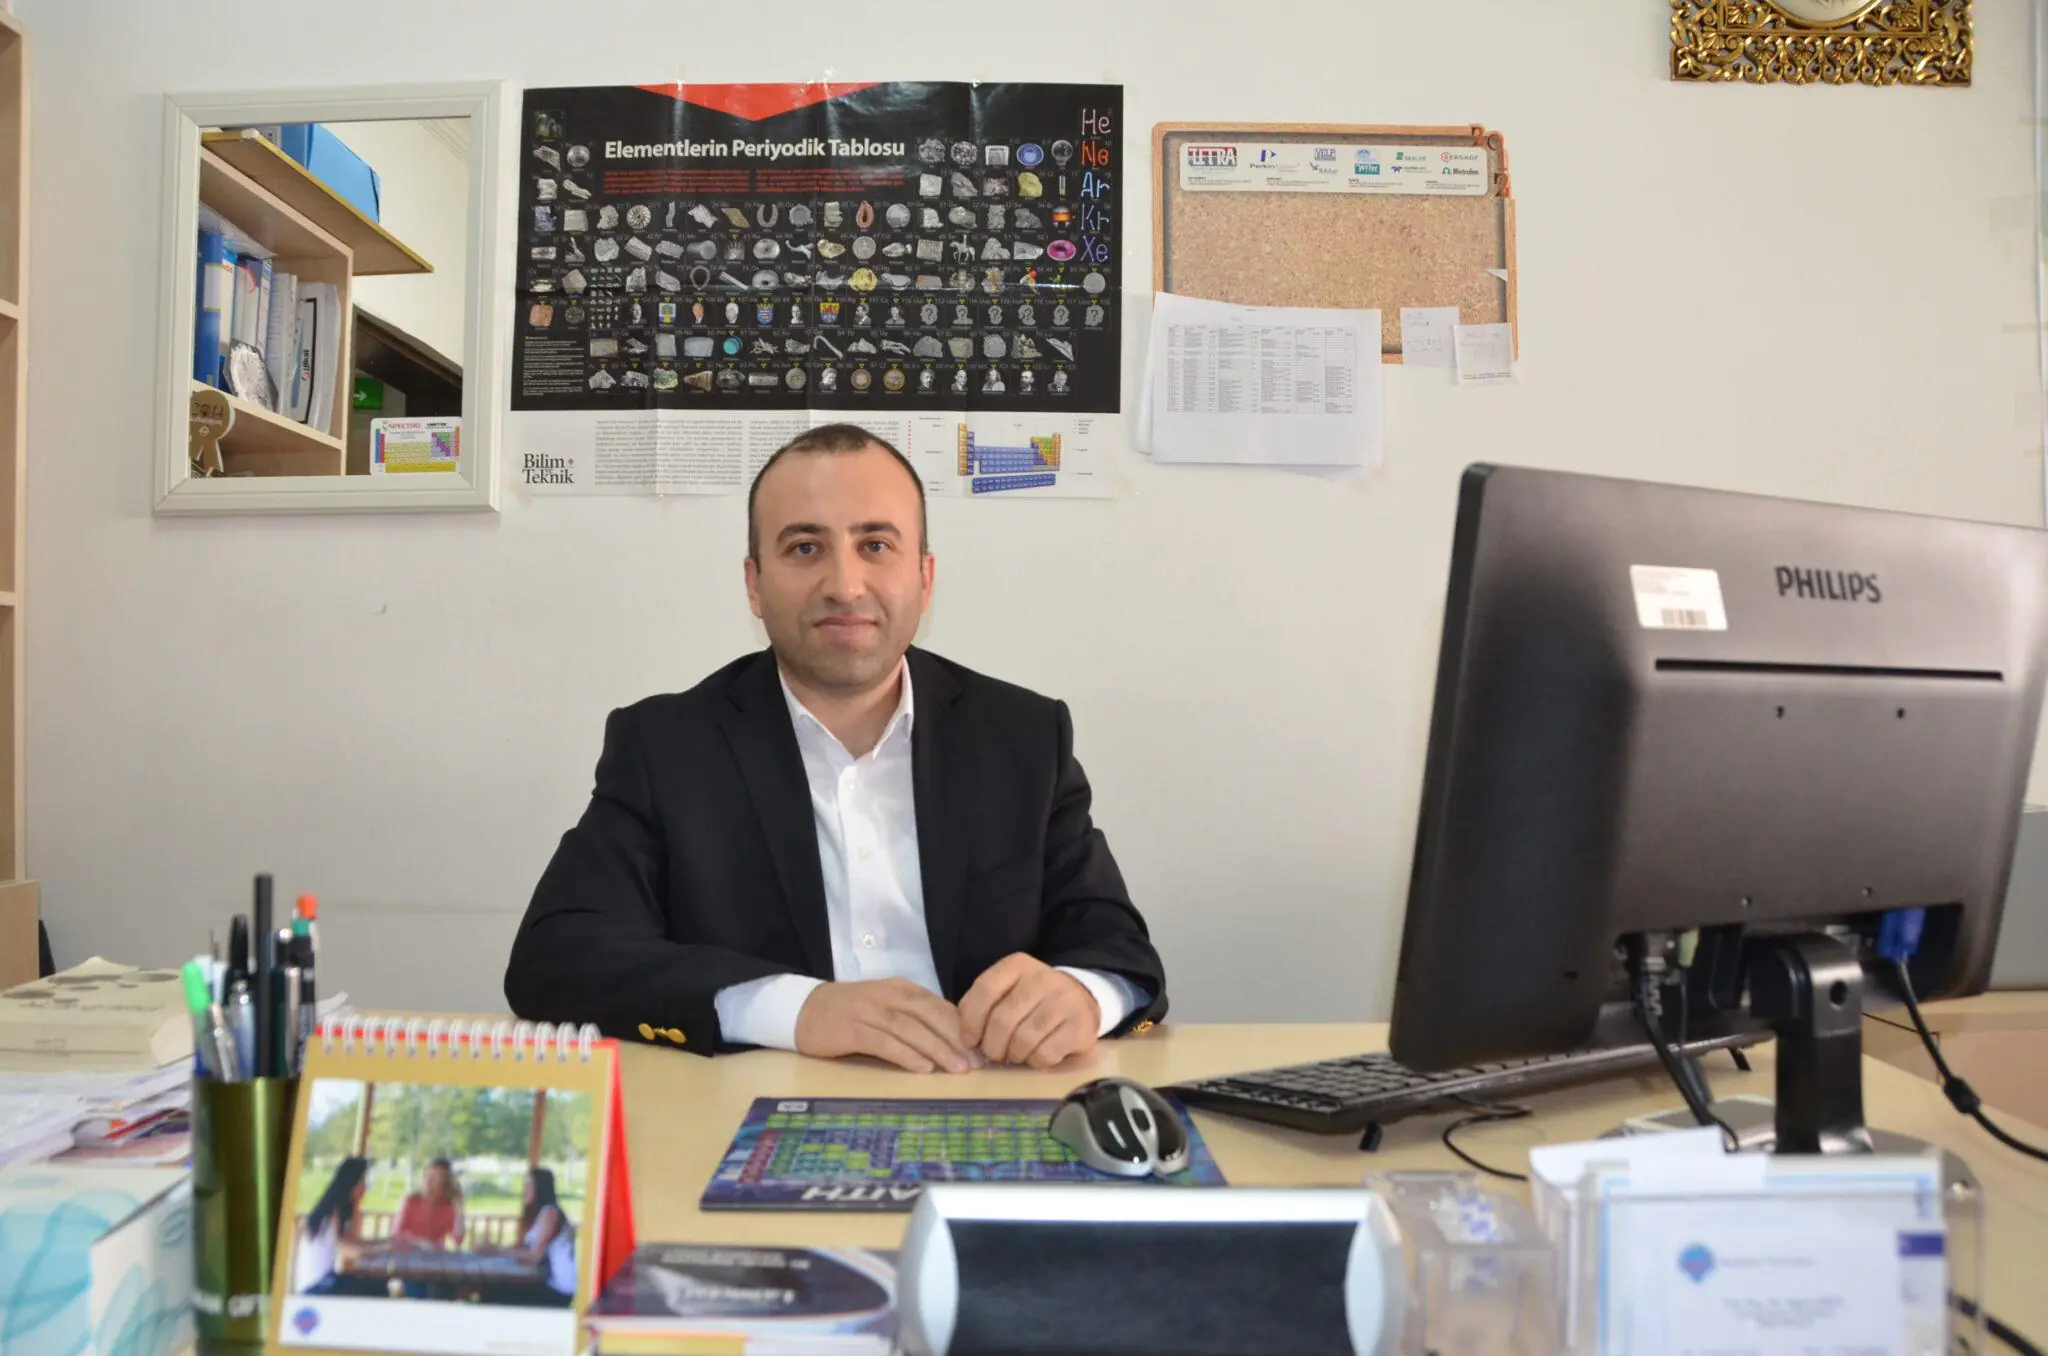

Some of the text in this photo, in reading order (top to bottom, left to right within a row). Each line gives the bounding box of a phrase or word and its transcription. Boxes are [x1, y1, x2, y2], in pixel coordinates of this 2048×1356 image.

[1081, 108, 1111, 135] He
[605, 138, 905, 161] Elementlerin Periyodik Tablosu
[1080, 171, 1110, 197] Ar
[1081, 204, 1110, 230] Kr
[1080, 235, 1108, 262] Xe
[524, 454, 564, 468] Bilim
[523, 468, 574, 484] Teknik
[1775, 566, 1882, 603] PHILIPS
